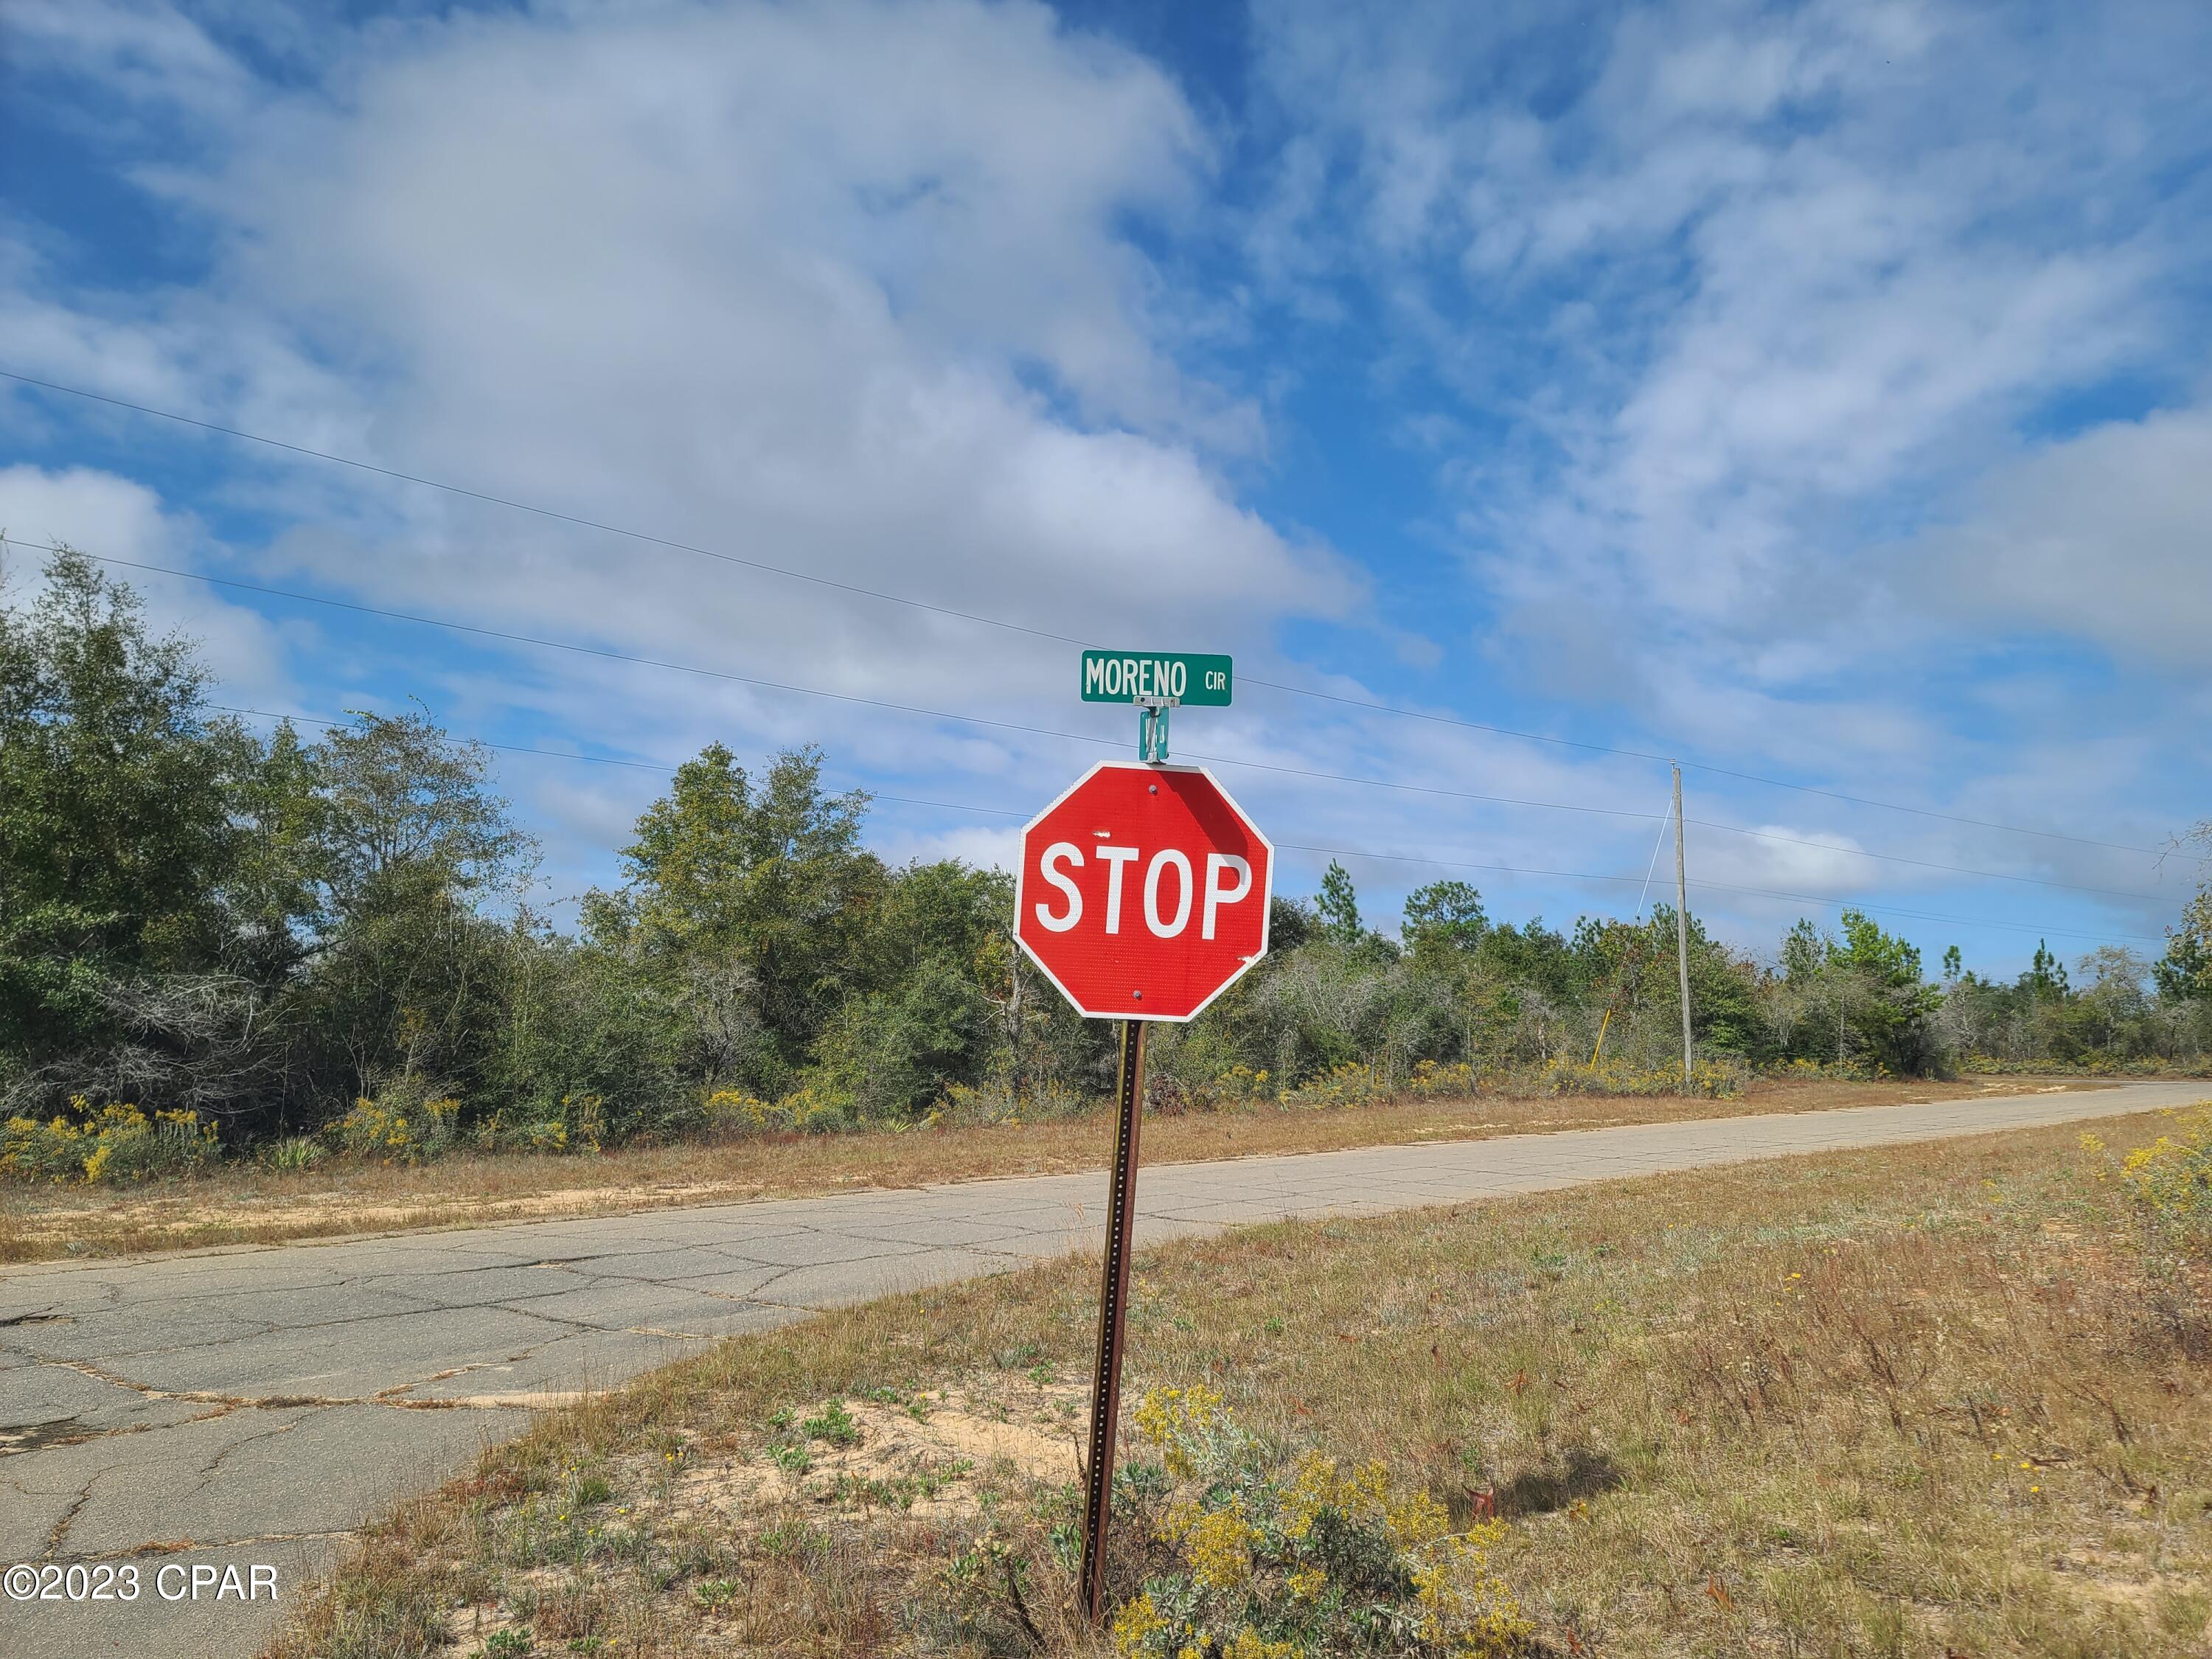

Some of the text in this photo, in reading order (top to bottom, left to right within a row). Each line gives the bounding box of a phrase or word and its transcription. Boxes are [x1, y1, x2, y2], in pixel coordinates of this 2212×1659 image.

[1085, 658, 1226, 697] MORENO CIR
[1035, 841, 1252, 940] STOP
